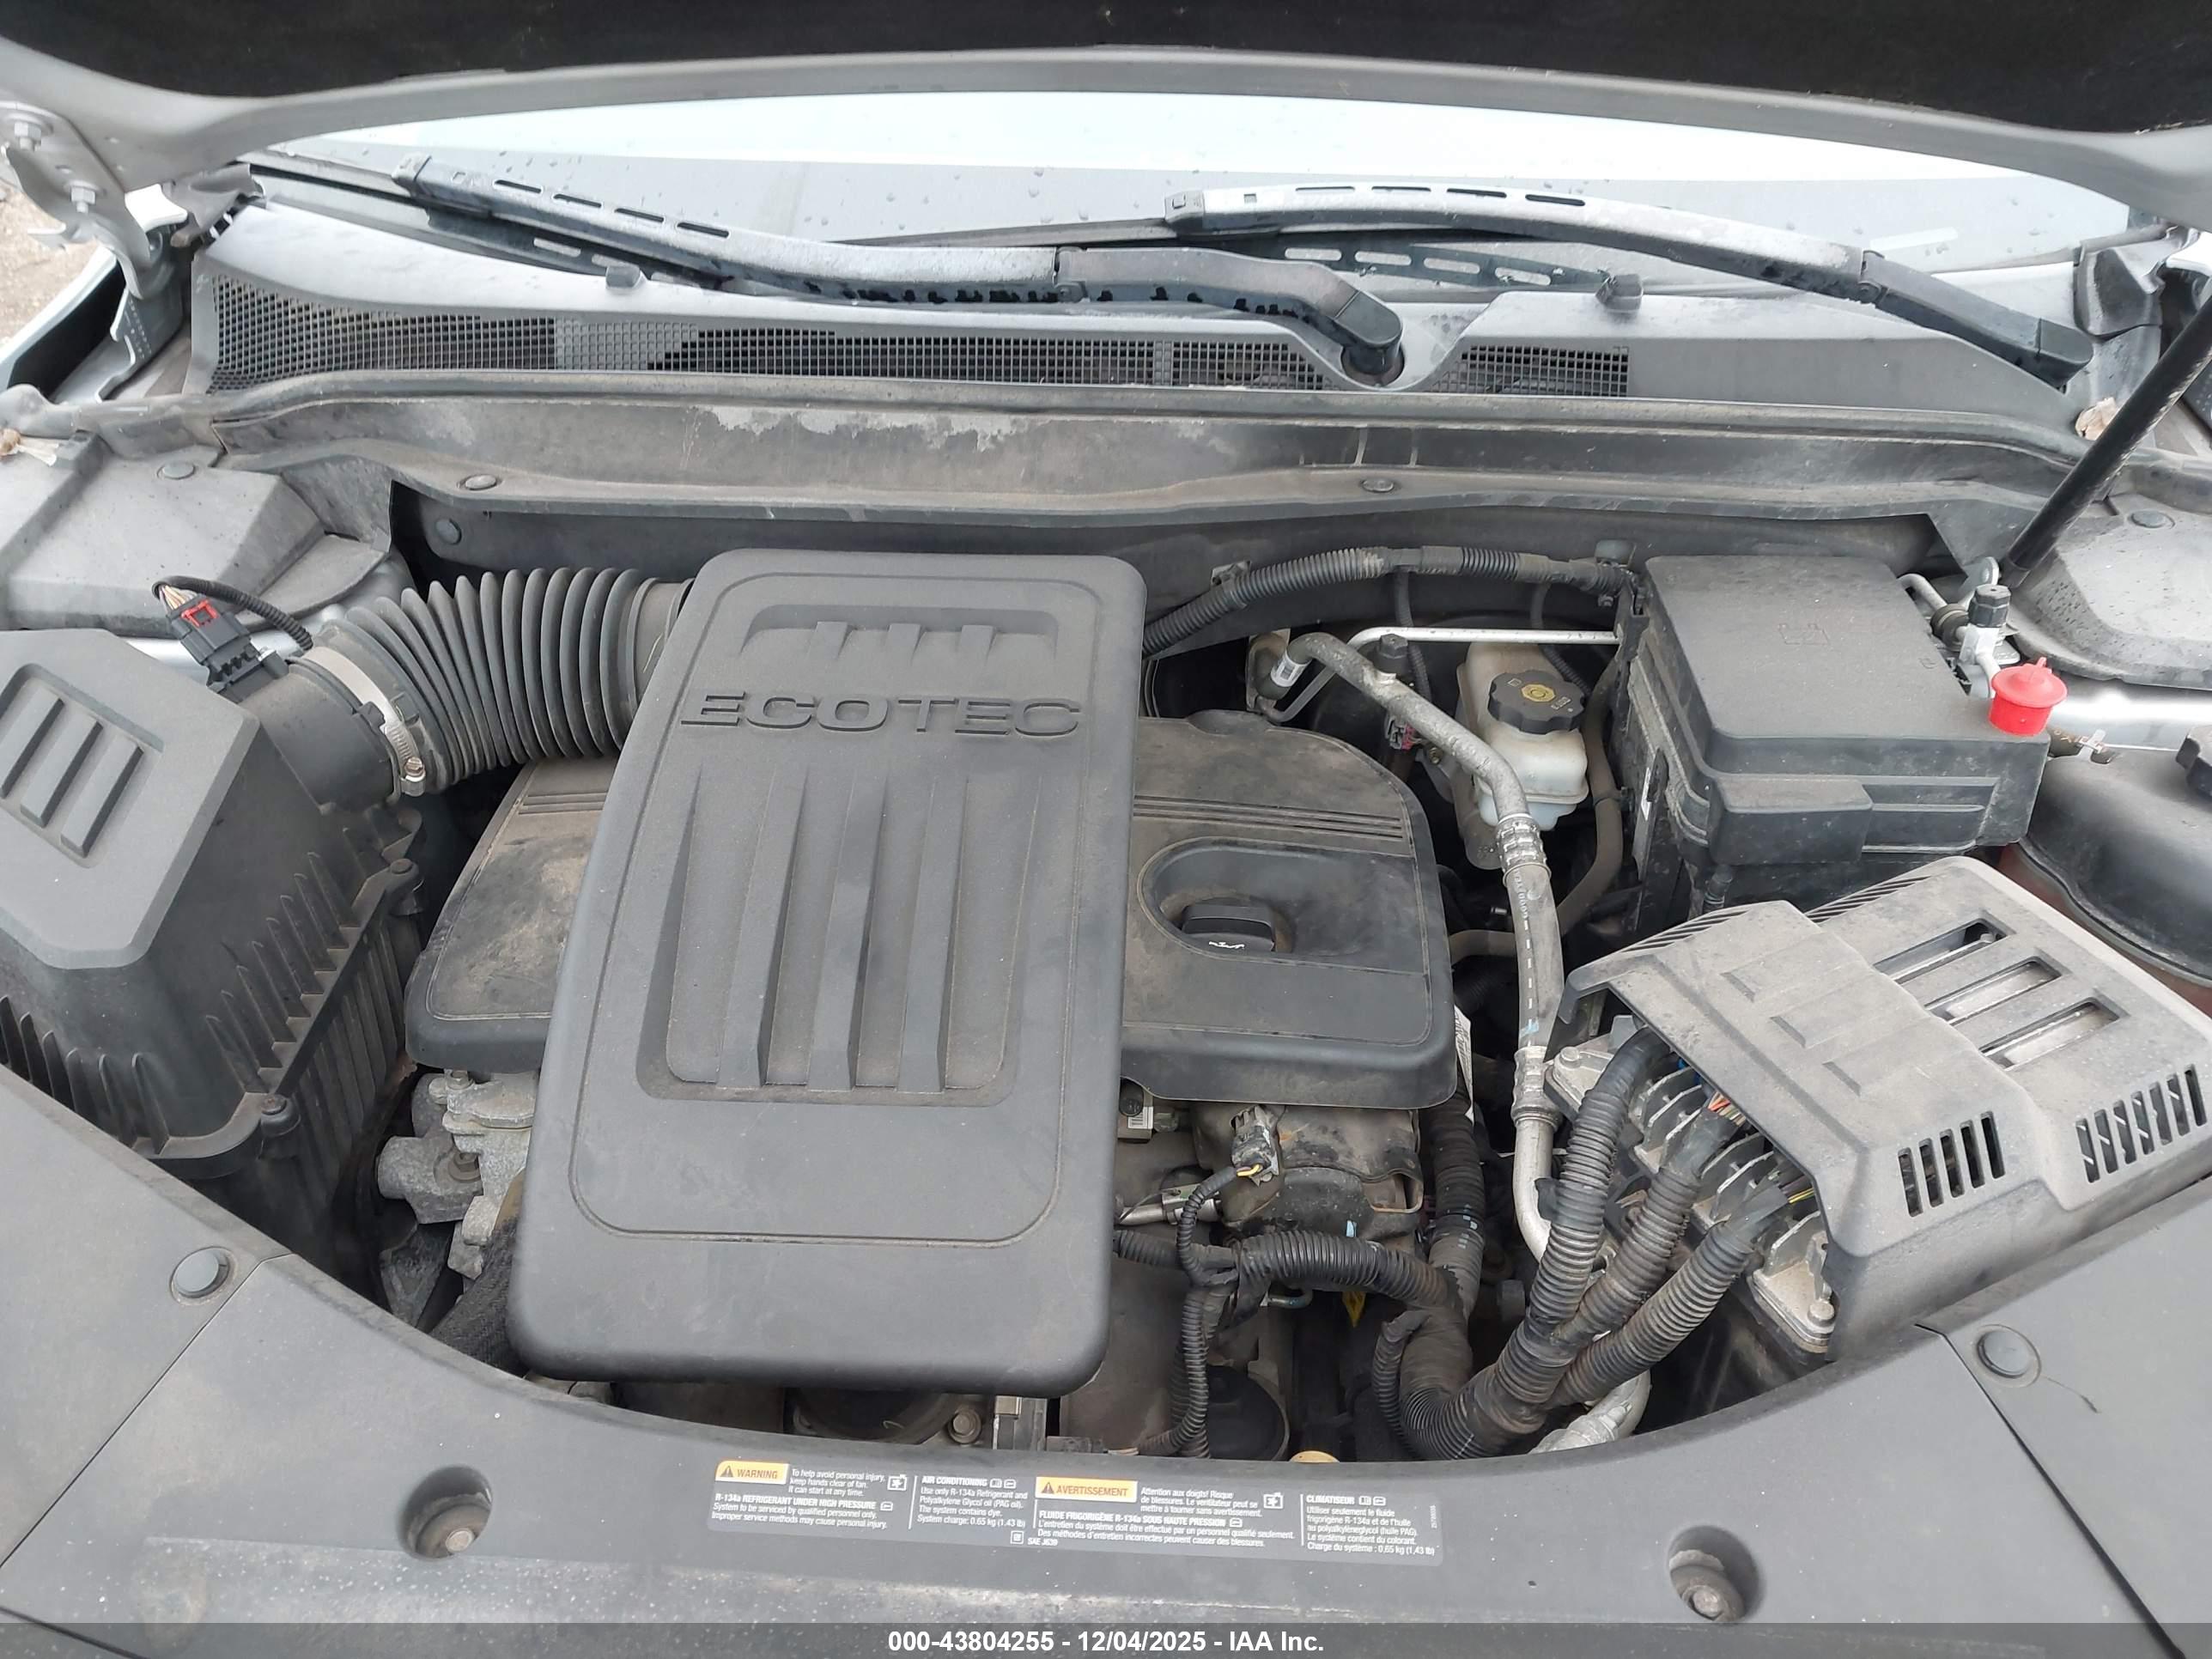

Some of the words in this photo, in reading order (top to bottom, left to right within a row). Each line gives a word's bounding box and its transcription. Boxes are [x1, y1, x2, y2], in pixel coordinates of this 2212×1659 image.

[681, 690, 1082, 737] ECOTEC
[738, 1469, 777, 1479] WARNING
[800, 1470, 815, 1479] help
[836, 1472, 864, 1480] personal
[936, 1477, 988, 1486] CONDITIONING
[977, 1490, 1013, 1499] Refrigerant
[1057, 1486, 1128, 1496] AVERTISSEMENT
[1186, 1490, 1209, 1498] doigts!
[1210, 1492, 1234, 1500] Risque
[742, 1495, 792, 1504] REFRIGERANT
[793, 1498, 817, 1506] UNDER
[838, 1500, 876, 1509] PRESSURE
[962, 1498, 981, 1507] Glycol
[1306, 1496, 1355, 1504] CLIMATISEUR
[827, 1509, 860, 1517] personnel
[933, 1506, 957, 1515] system
[1213, 1509, 1262, 1517] avertissement.
[712, 1512, 743, 1521] Improper
[836, 1518, 866, 1527] personal
[867, 1520, 887, 1528] injury.
[917, 1515, 942, 1524] System
[944, 1516, 969, 1525] charge:
[1115, 1514, 1141, 1522] R-134a
[1164, 1516, 1188, 1525] HAUTE
[1189, 1517, 1226, 1527] PRESSION
[1307, 1516, 1343, 1524] frigorigène
[1197, 1528, 1230, 1536] personnel
[1231, 1529, 1255, 1538] qualifié
[1380, 1528, 1399, 1536] (huile
[1164, 1535, 1191, 1544] peuvent
[1308, 1543, 1332, 1552] Charge
[1345, 1545, 1372, 1553] système
